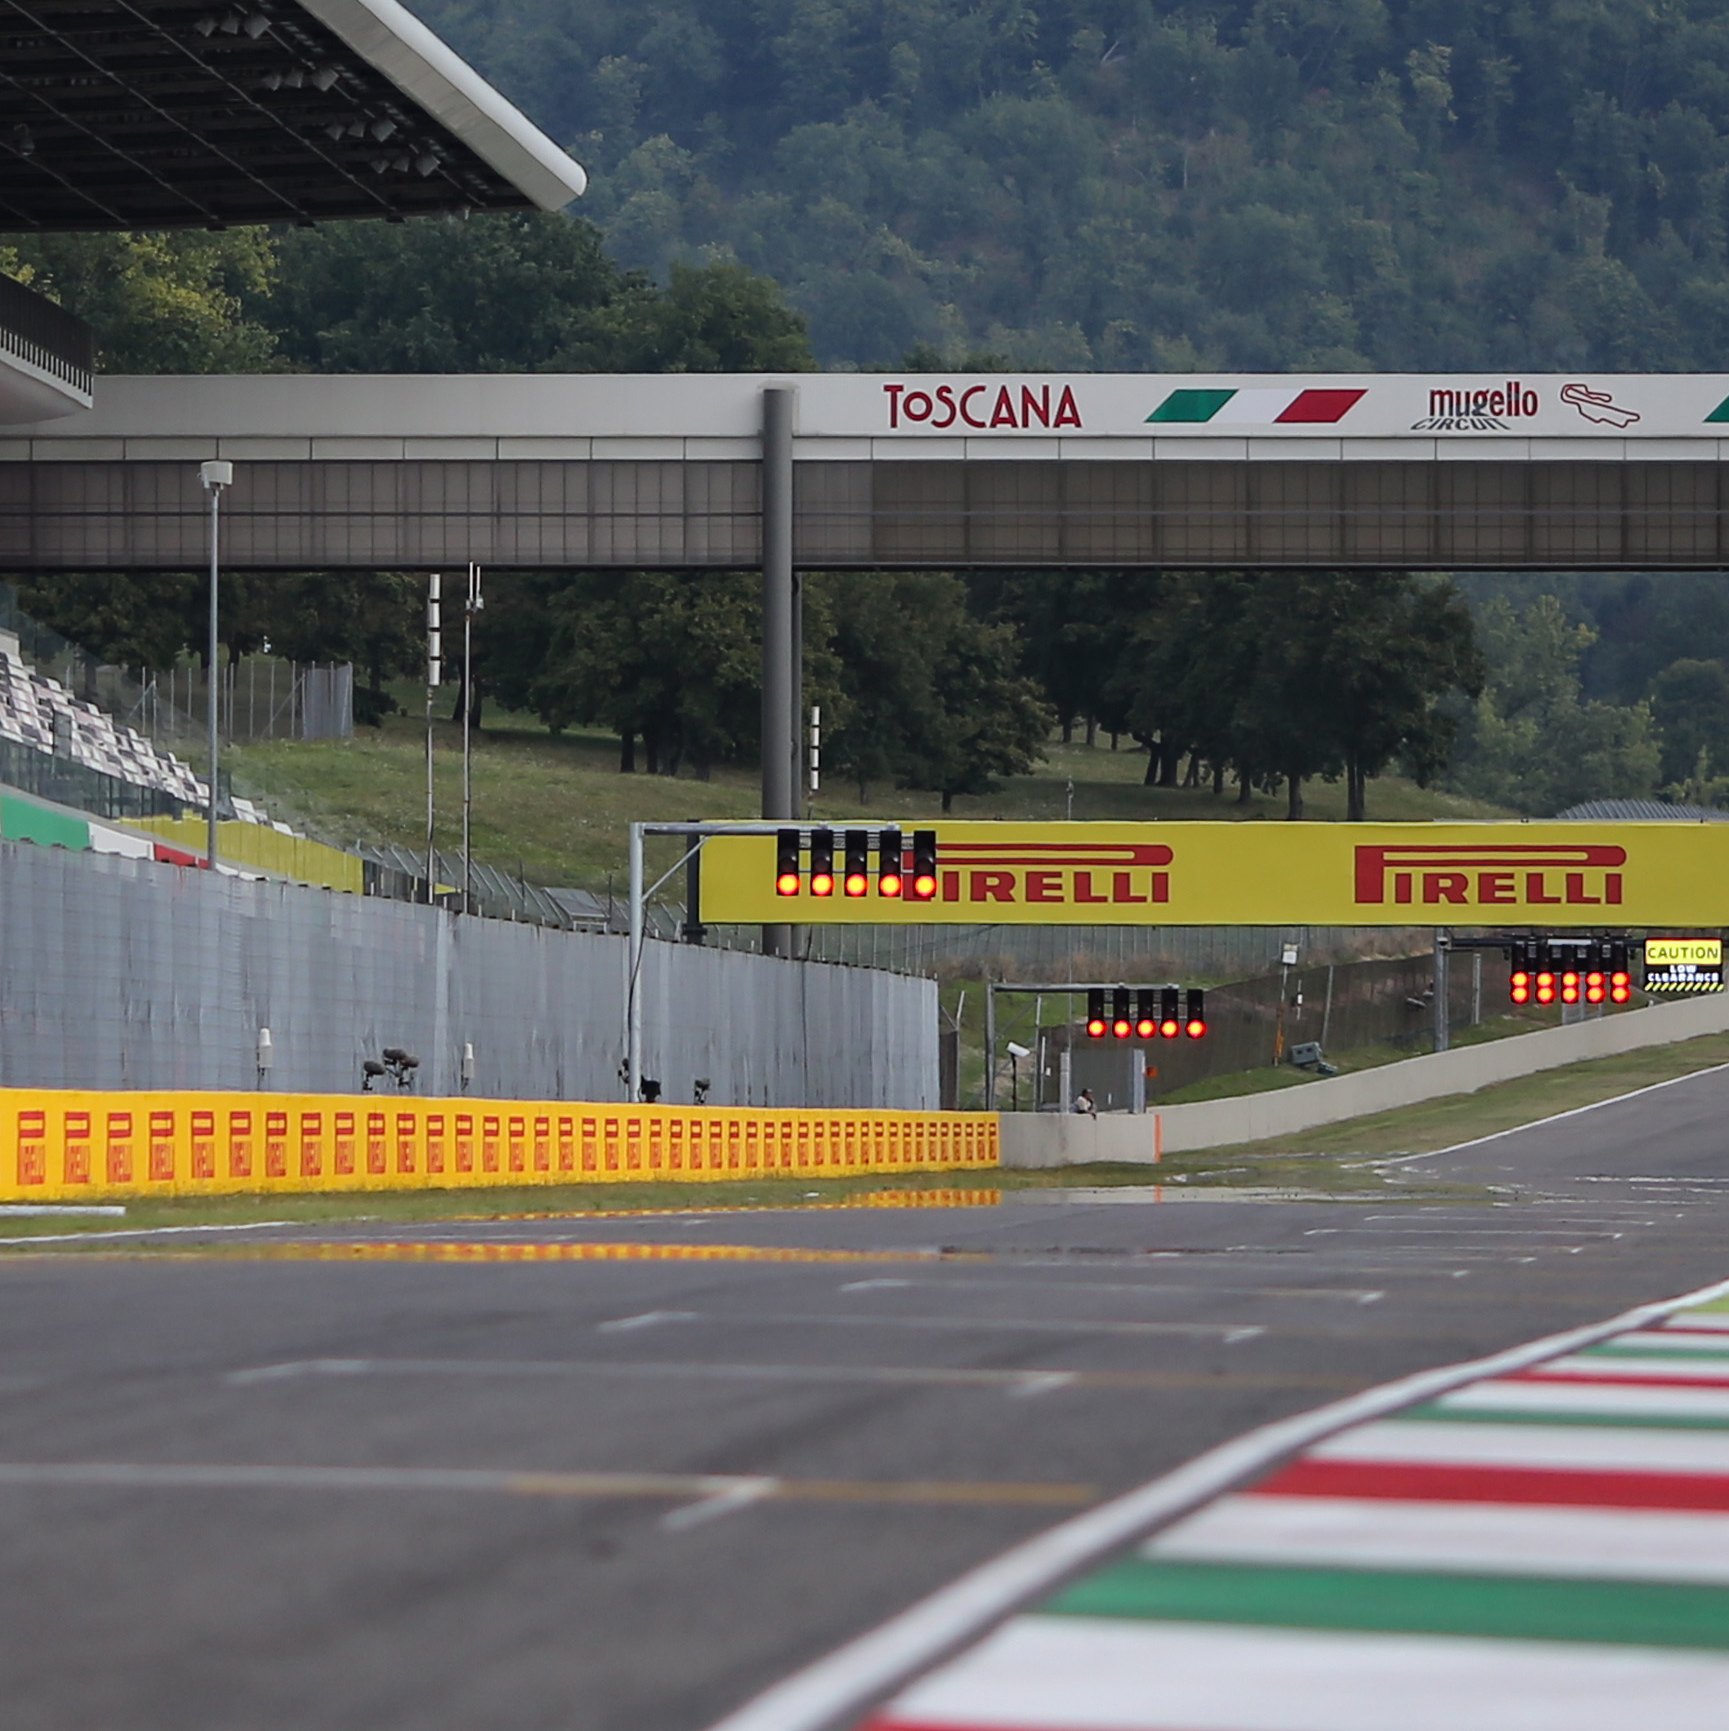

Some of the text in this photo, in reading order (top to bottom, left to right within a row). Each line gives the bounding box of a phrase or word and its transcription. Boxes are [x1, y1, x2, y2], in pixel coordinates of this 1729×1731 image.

[1429, 381, 1538, 417] mugello
[1410, 417, 1511, 431] CIRCUIT
[1355, 845, 1627, 904] PIRELLI
[1647, 947, 1718, 959] CAUTION
[1669, 965, 1697, 973] LOW
[1647, 973, 1719, 983] CLEARANCE
